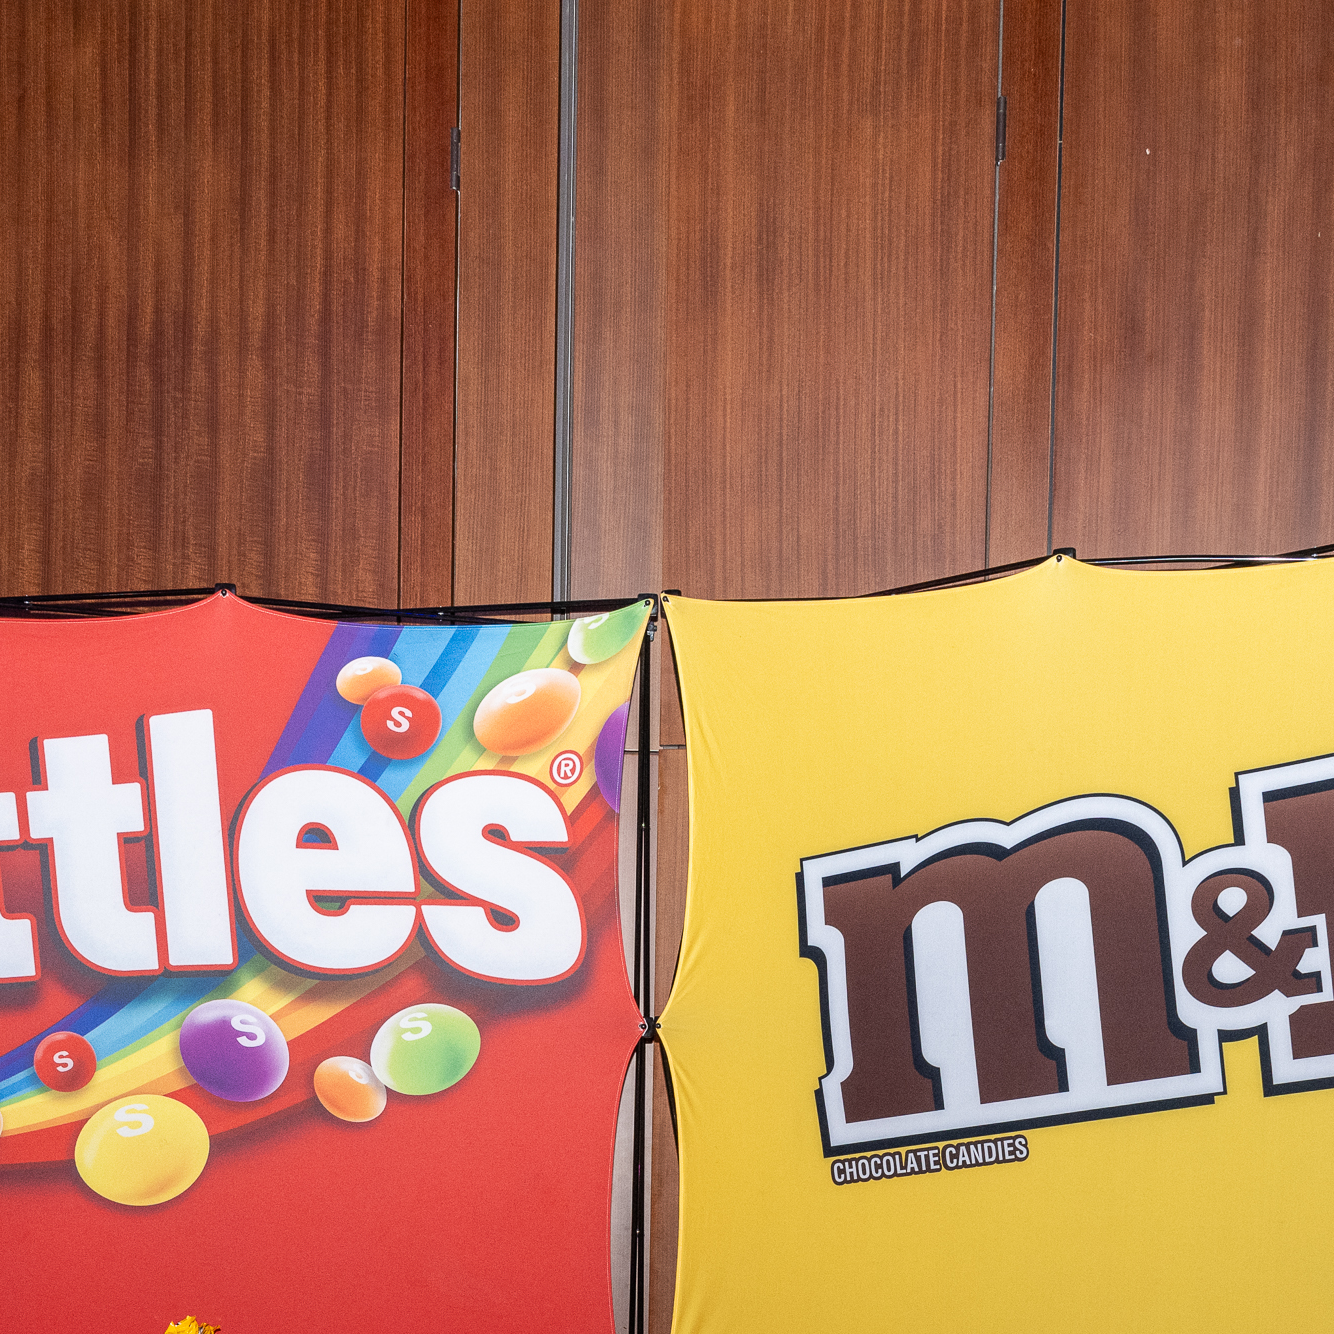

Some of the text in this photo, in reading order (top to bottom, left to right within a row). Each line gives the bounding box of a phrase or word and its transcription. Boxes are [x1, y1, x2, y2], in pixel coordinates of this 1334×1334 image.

[386, 705, 413, 733] S
[231, 1013, 267, 1047] S
[399, 1011, 434, 1043] S
[53, 1050, 74, 1073] S
[113, 1103, 156, 1139] S
[832, 1137, 1028, 1184] CHOCOLATE CANDIES
